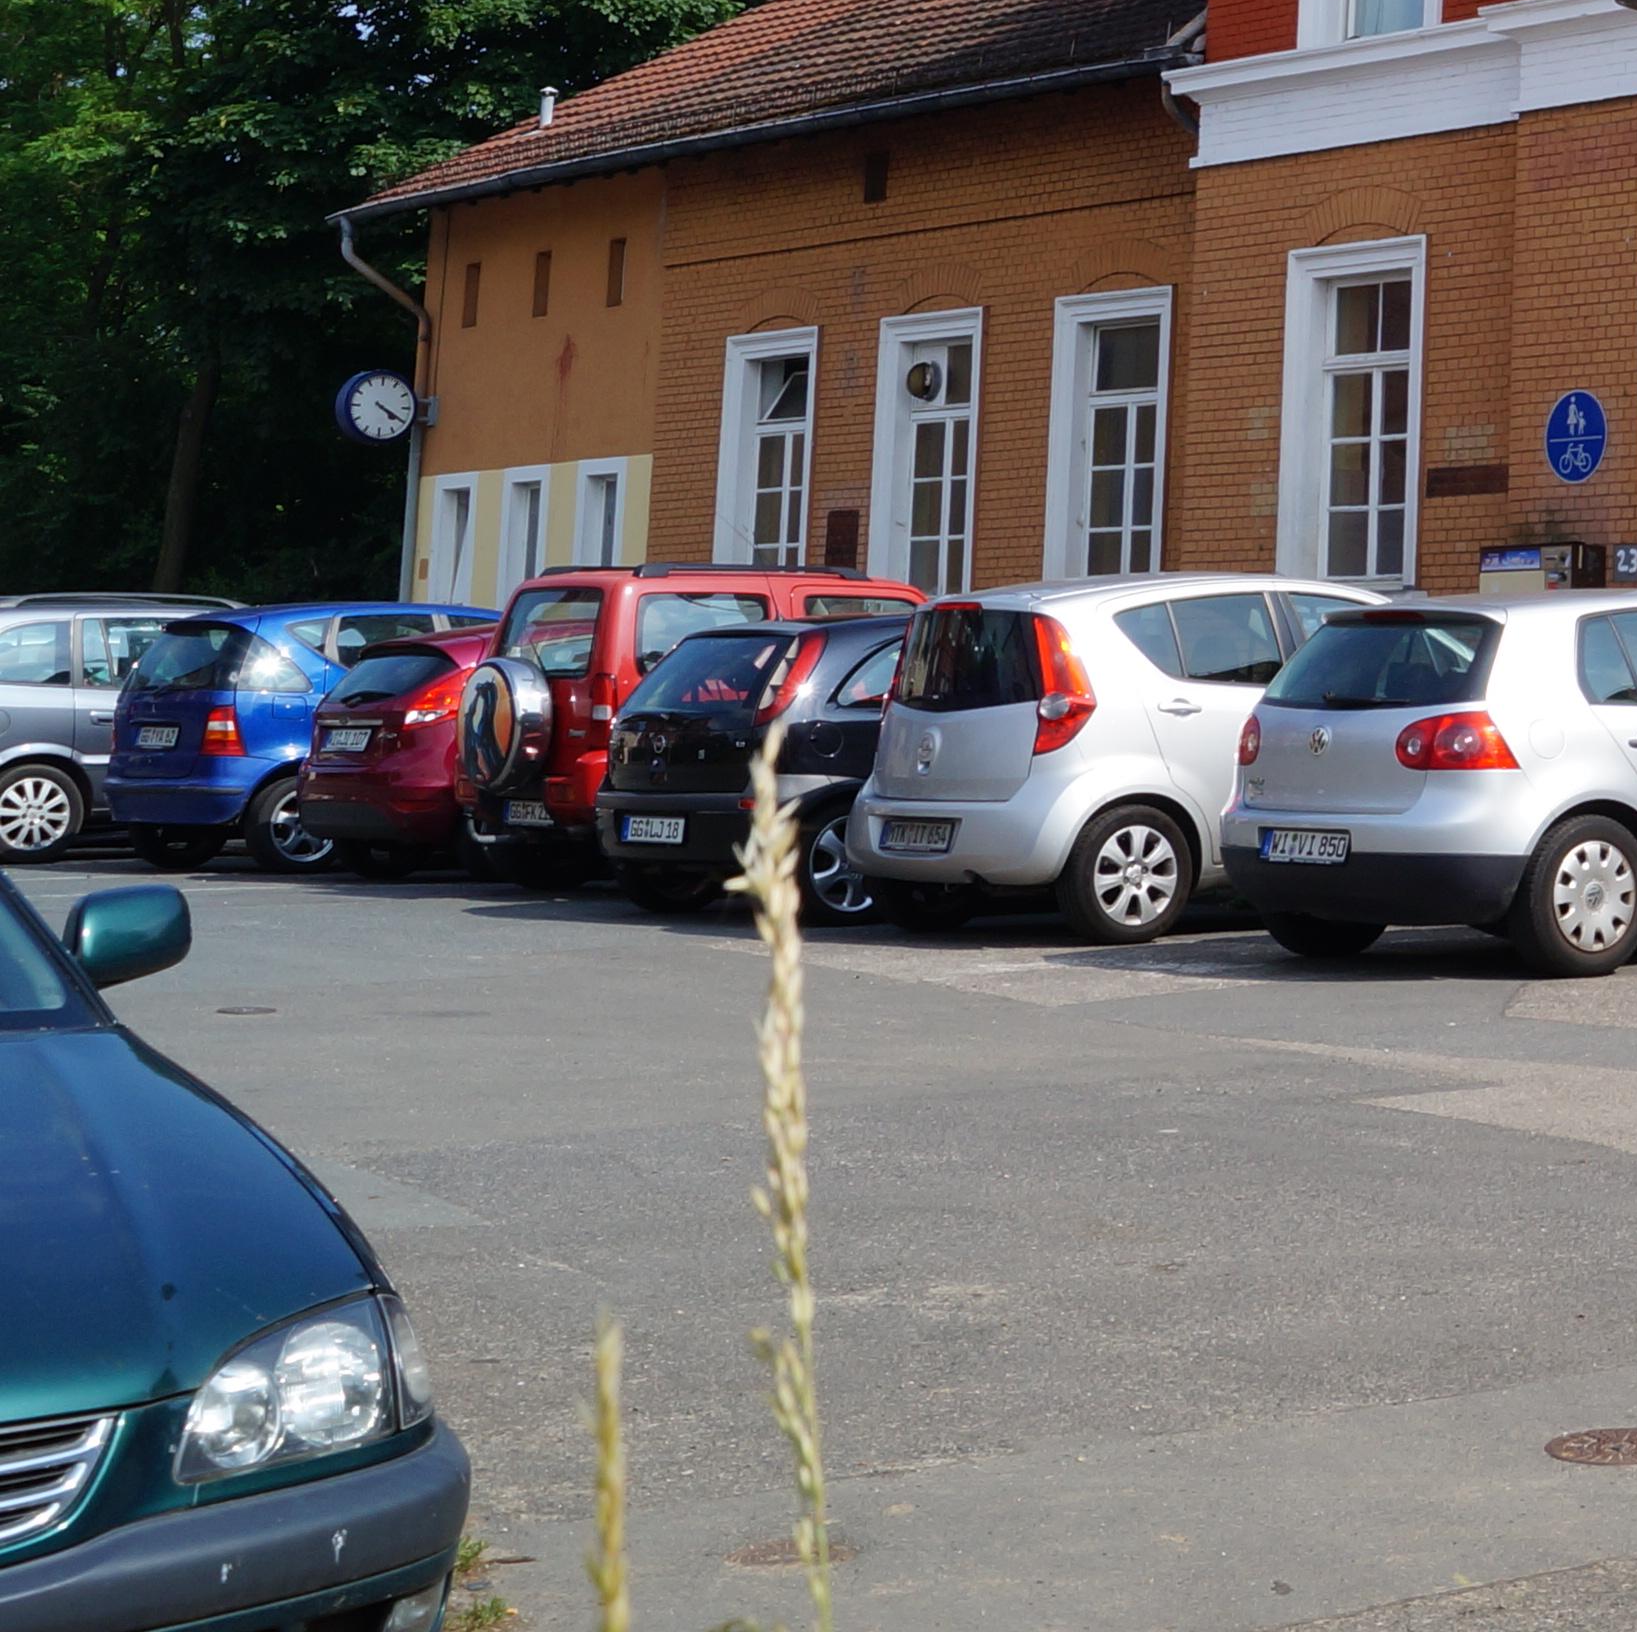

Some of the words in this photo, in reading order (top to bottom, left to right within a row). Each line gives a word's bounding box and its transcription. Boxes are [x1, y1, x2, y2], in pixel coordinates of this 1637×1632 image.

[631, 820, 644, 837] GG
[650, 821, 664, 838] LJ
[666, 821, 679, 839] 18
[1272, 833, 1288, 854] WI
[1298, 834, 1316, 856] VI
[1318, 836, 1347, 858] 850
